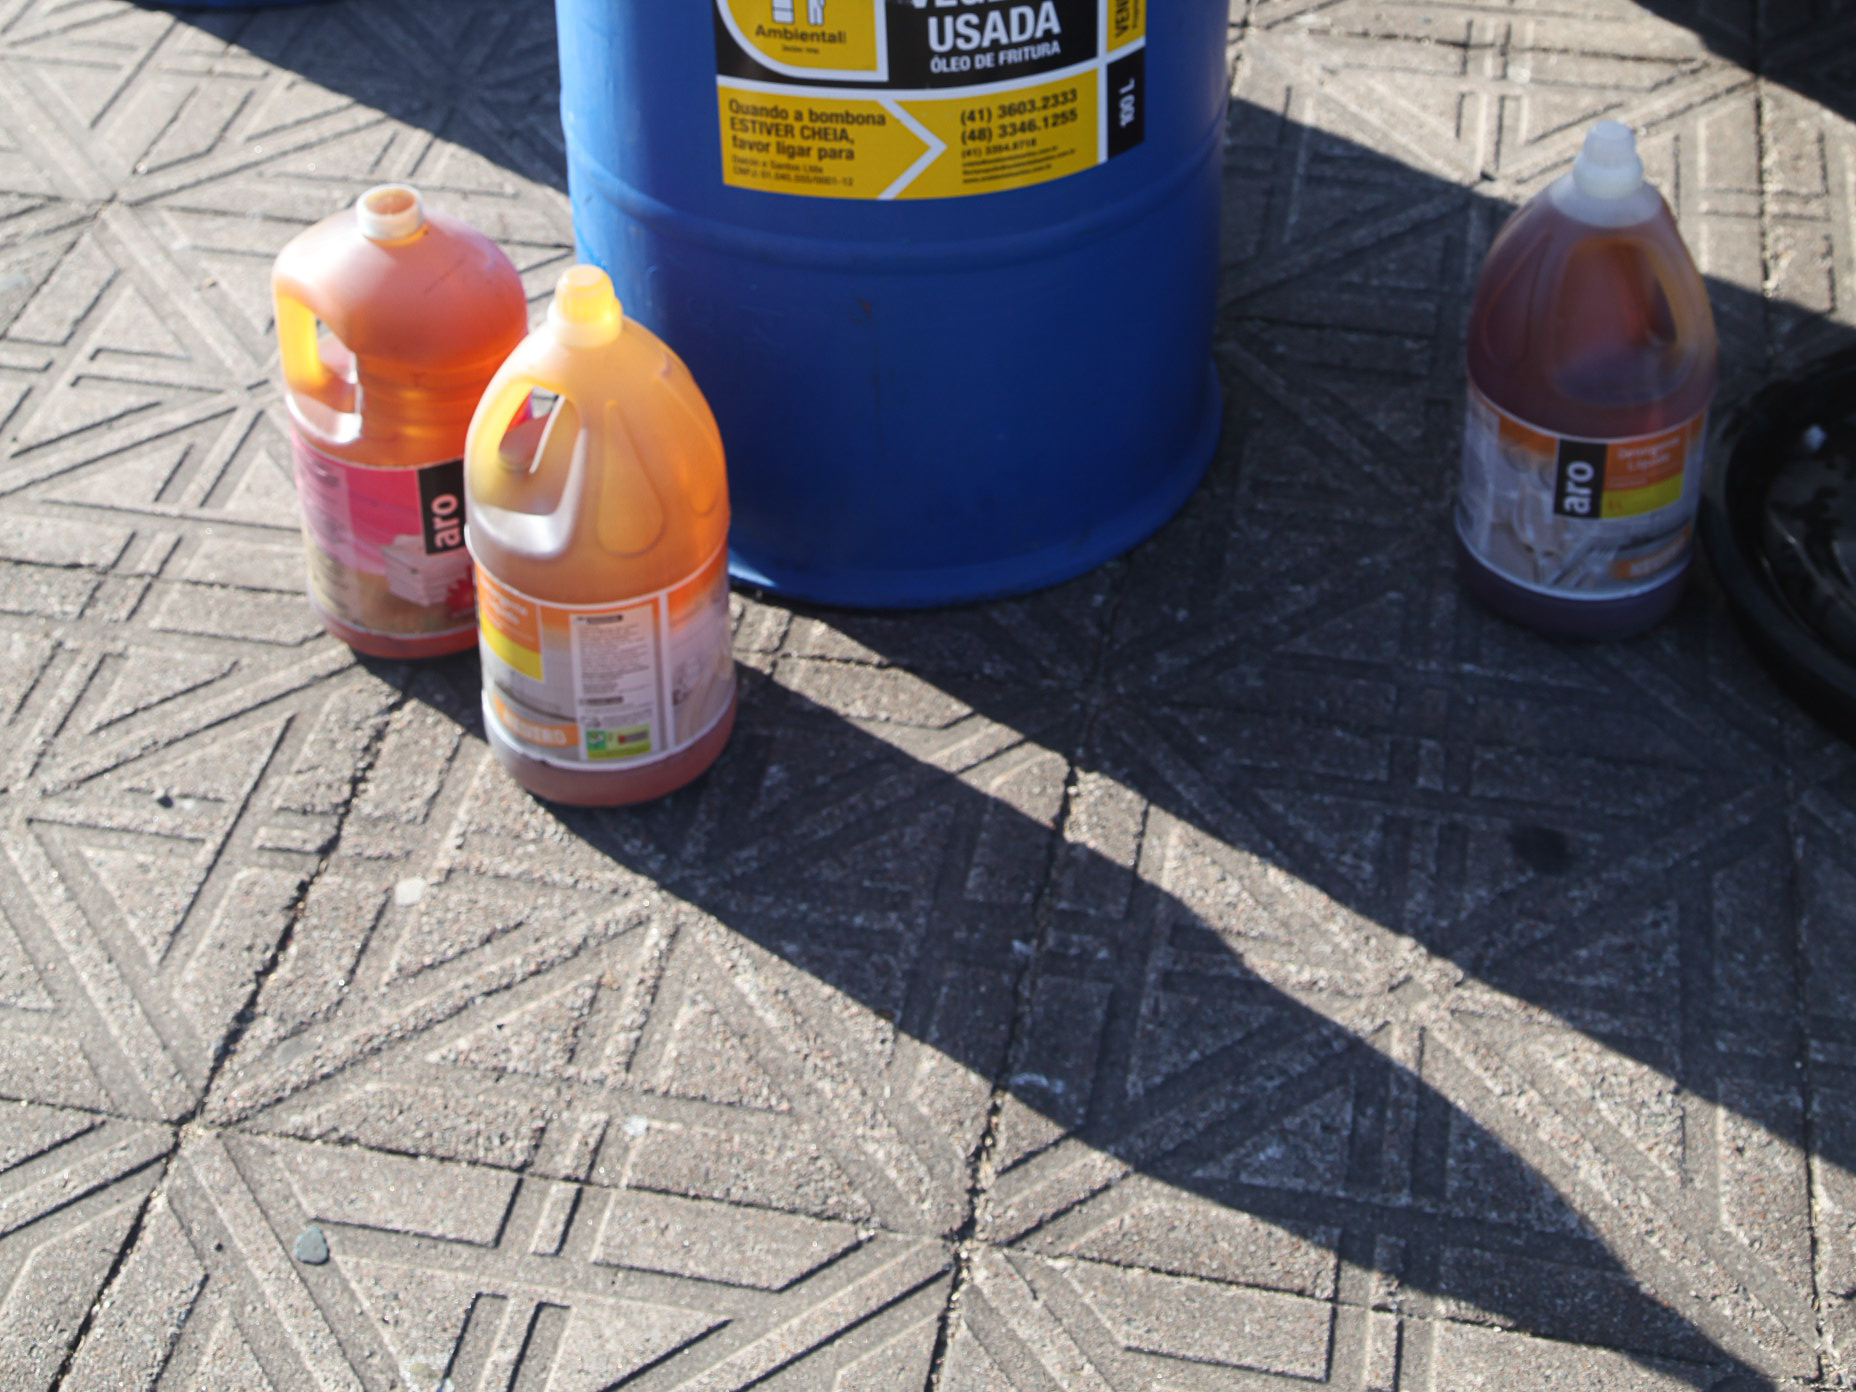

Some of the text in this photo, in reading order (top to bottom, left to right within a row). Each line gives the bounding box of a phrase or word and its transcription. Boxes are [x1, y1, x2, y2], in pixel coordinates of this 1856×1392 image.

[927, 0, 1062, 54] USADA
[930, 39, 1061, 74] ÓLEO DE FRITURA
[728, 98, 887, 127] Quando a bombona
[960, 106, 992, 127] (41)
[1118, 77, 1136, 128] 100 L
[729, 116, 856, 145] ESTIVER CHEIA,
[960, 126, 993, 146] (48)
[731, 135, 855, 162] favor ligar para
[1564, 460, 1595, 515] aro
[431, 492, 462, 550] aro
